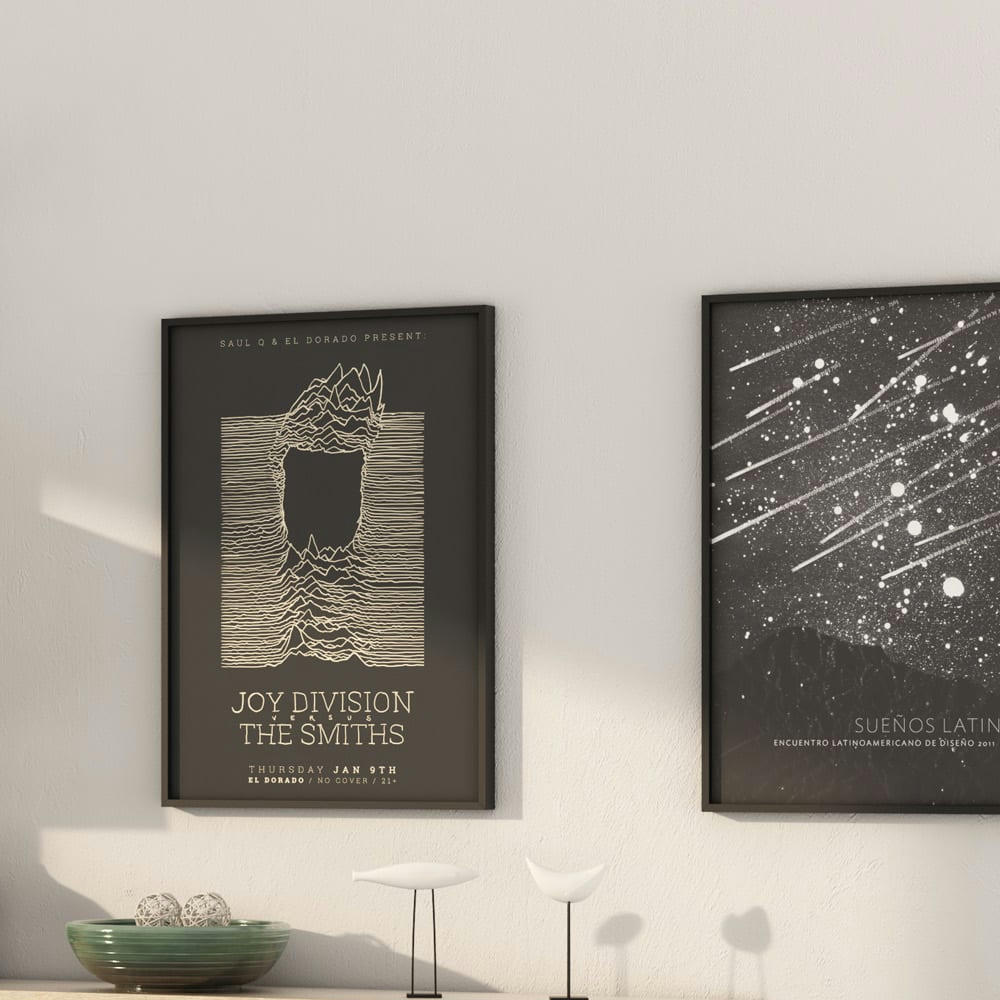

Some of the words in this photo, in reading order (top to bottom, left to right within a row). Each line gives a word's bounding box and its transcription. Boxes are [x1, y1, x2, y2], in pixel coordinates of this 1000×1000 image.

[220, 338, 251, 348] SAUL
[258, 338, 265, 347] Q
[272, 338, 278, 346] &
[285, 336, 299, 346] EL
[306, 334, 357, 344] DORADO
[231, 692, 285, 714] JOY
[292, 690, 414, 714] DIVISION
[854, 714, 936, 734] SUEÑOS
[239, 724, 293, 745] THE
[301, 722, 405, 745] SMITHS
[774, 738, 828, 748] ENCUENTRO
[832, 738, 922, 748] LATINOAMERICANO
[925, 738, 937, 748] DE
[940, 737, 975, 748] DISEÑO
[248, 766, 324, 774] THURSDAY
[332, 766, 360, 774] JAN
[370, 766, 396, 774] 9TH
